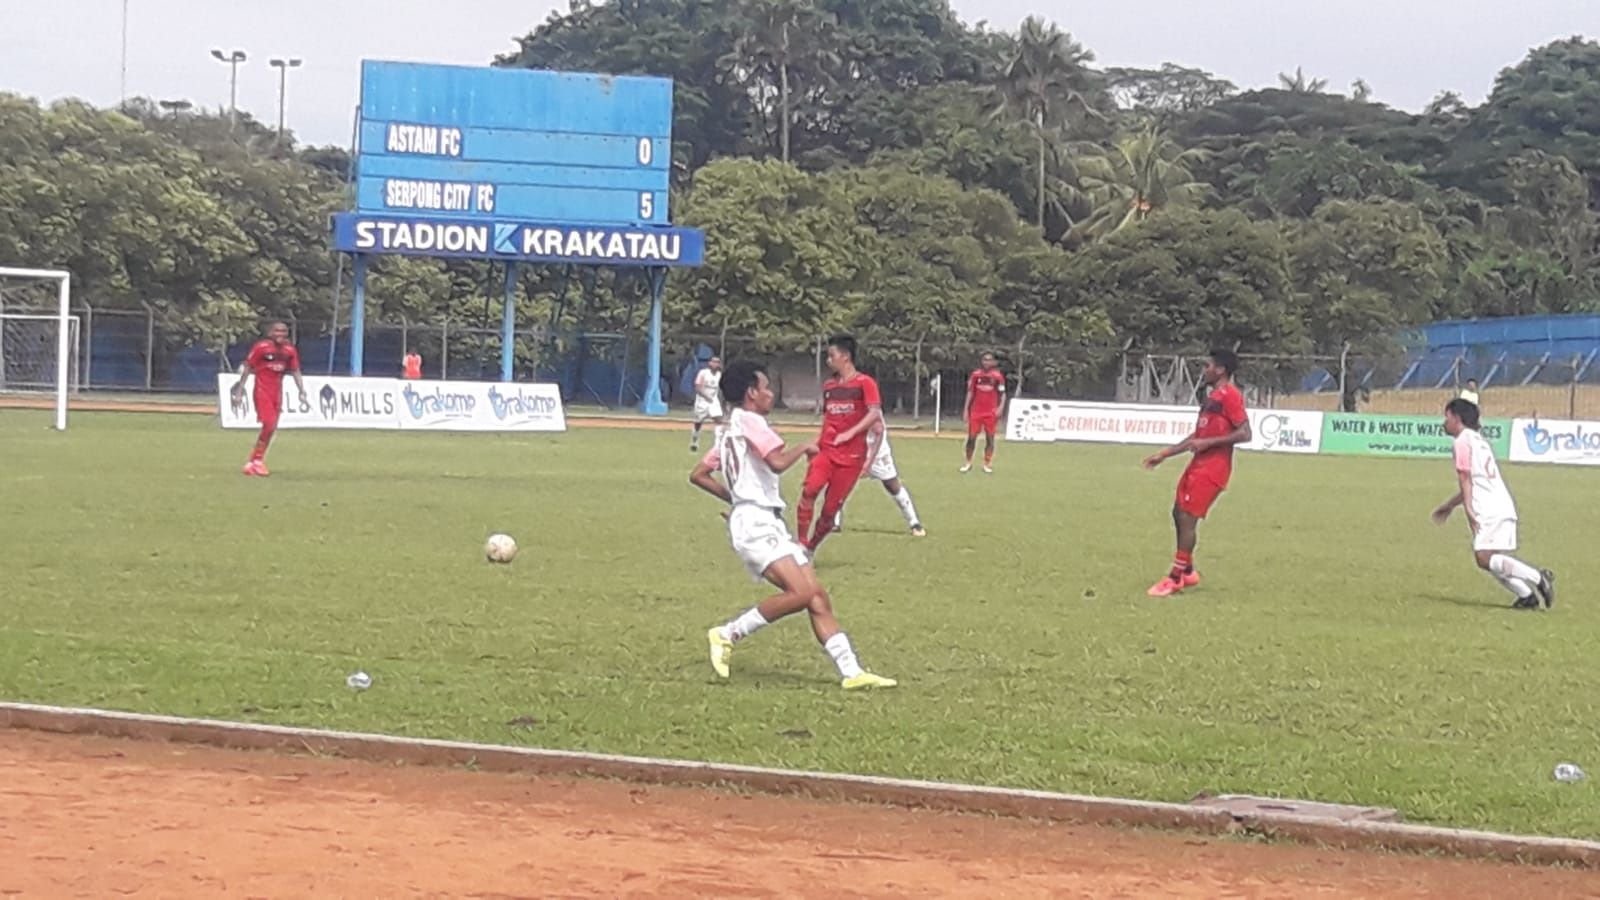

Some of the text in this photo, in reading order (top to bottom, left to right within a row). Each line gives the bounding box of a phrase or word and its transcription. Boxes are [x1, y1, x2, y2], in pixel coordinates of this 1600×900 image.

[387, 124, 462, 157] ASTAM FC
[638, 137, 651, 165] 0
[386, 179, 494, 212] SERPONG CITY FC
[640, 192, 652, 219] 5
[355, 221, 488, 252] STADION
[523, 228, 681, 260] KRAKATAU
[340, 391, 394, 415] MILLS
[1058, 415, 1121, 433] CHEMICAL
[1123, 418, 1167, 435] WATER
[1332, 419, 1365, 433] WATER
[1379, 421, 1414, 436] WASTE
[1416, 423, 1446, 437] WATE
